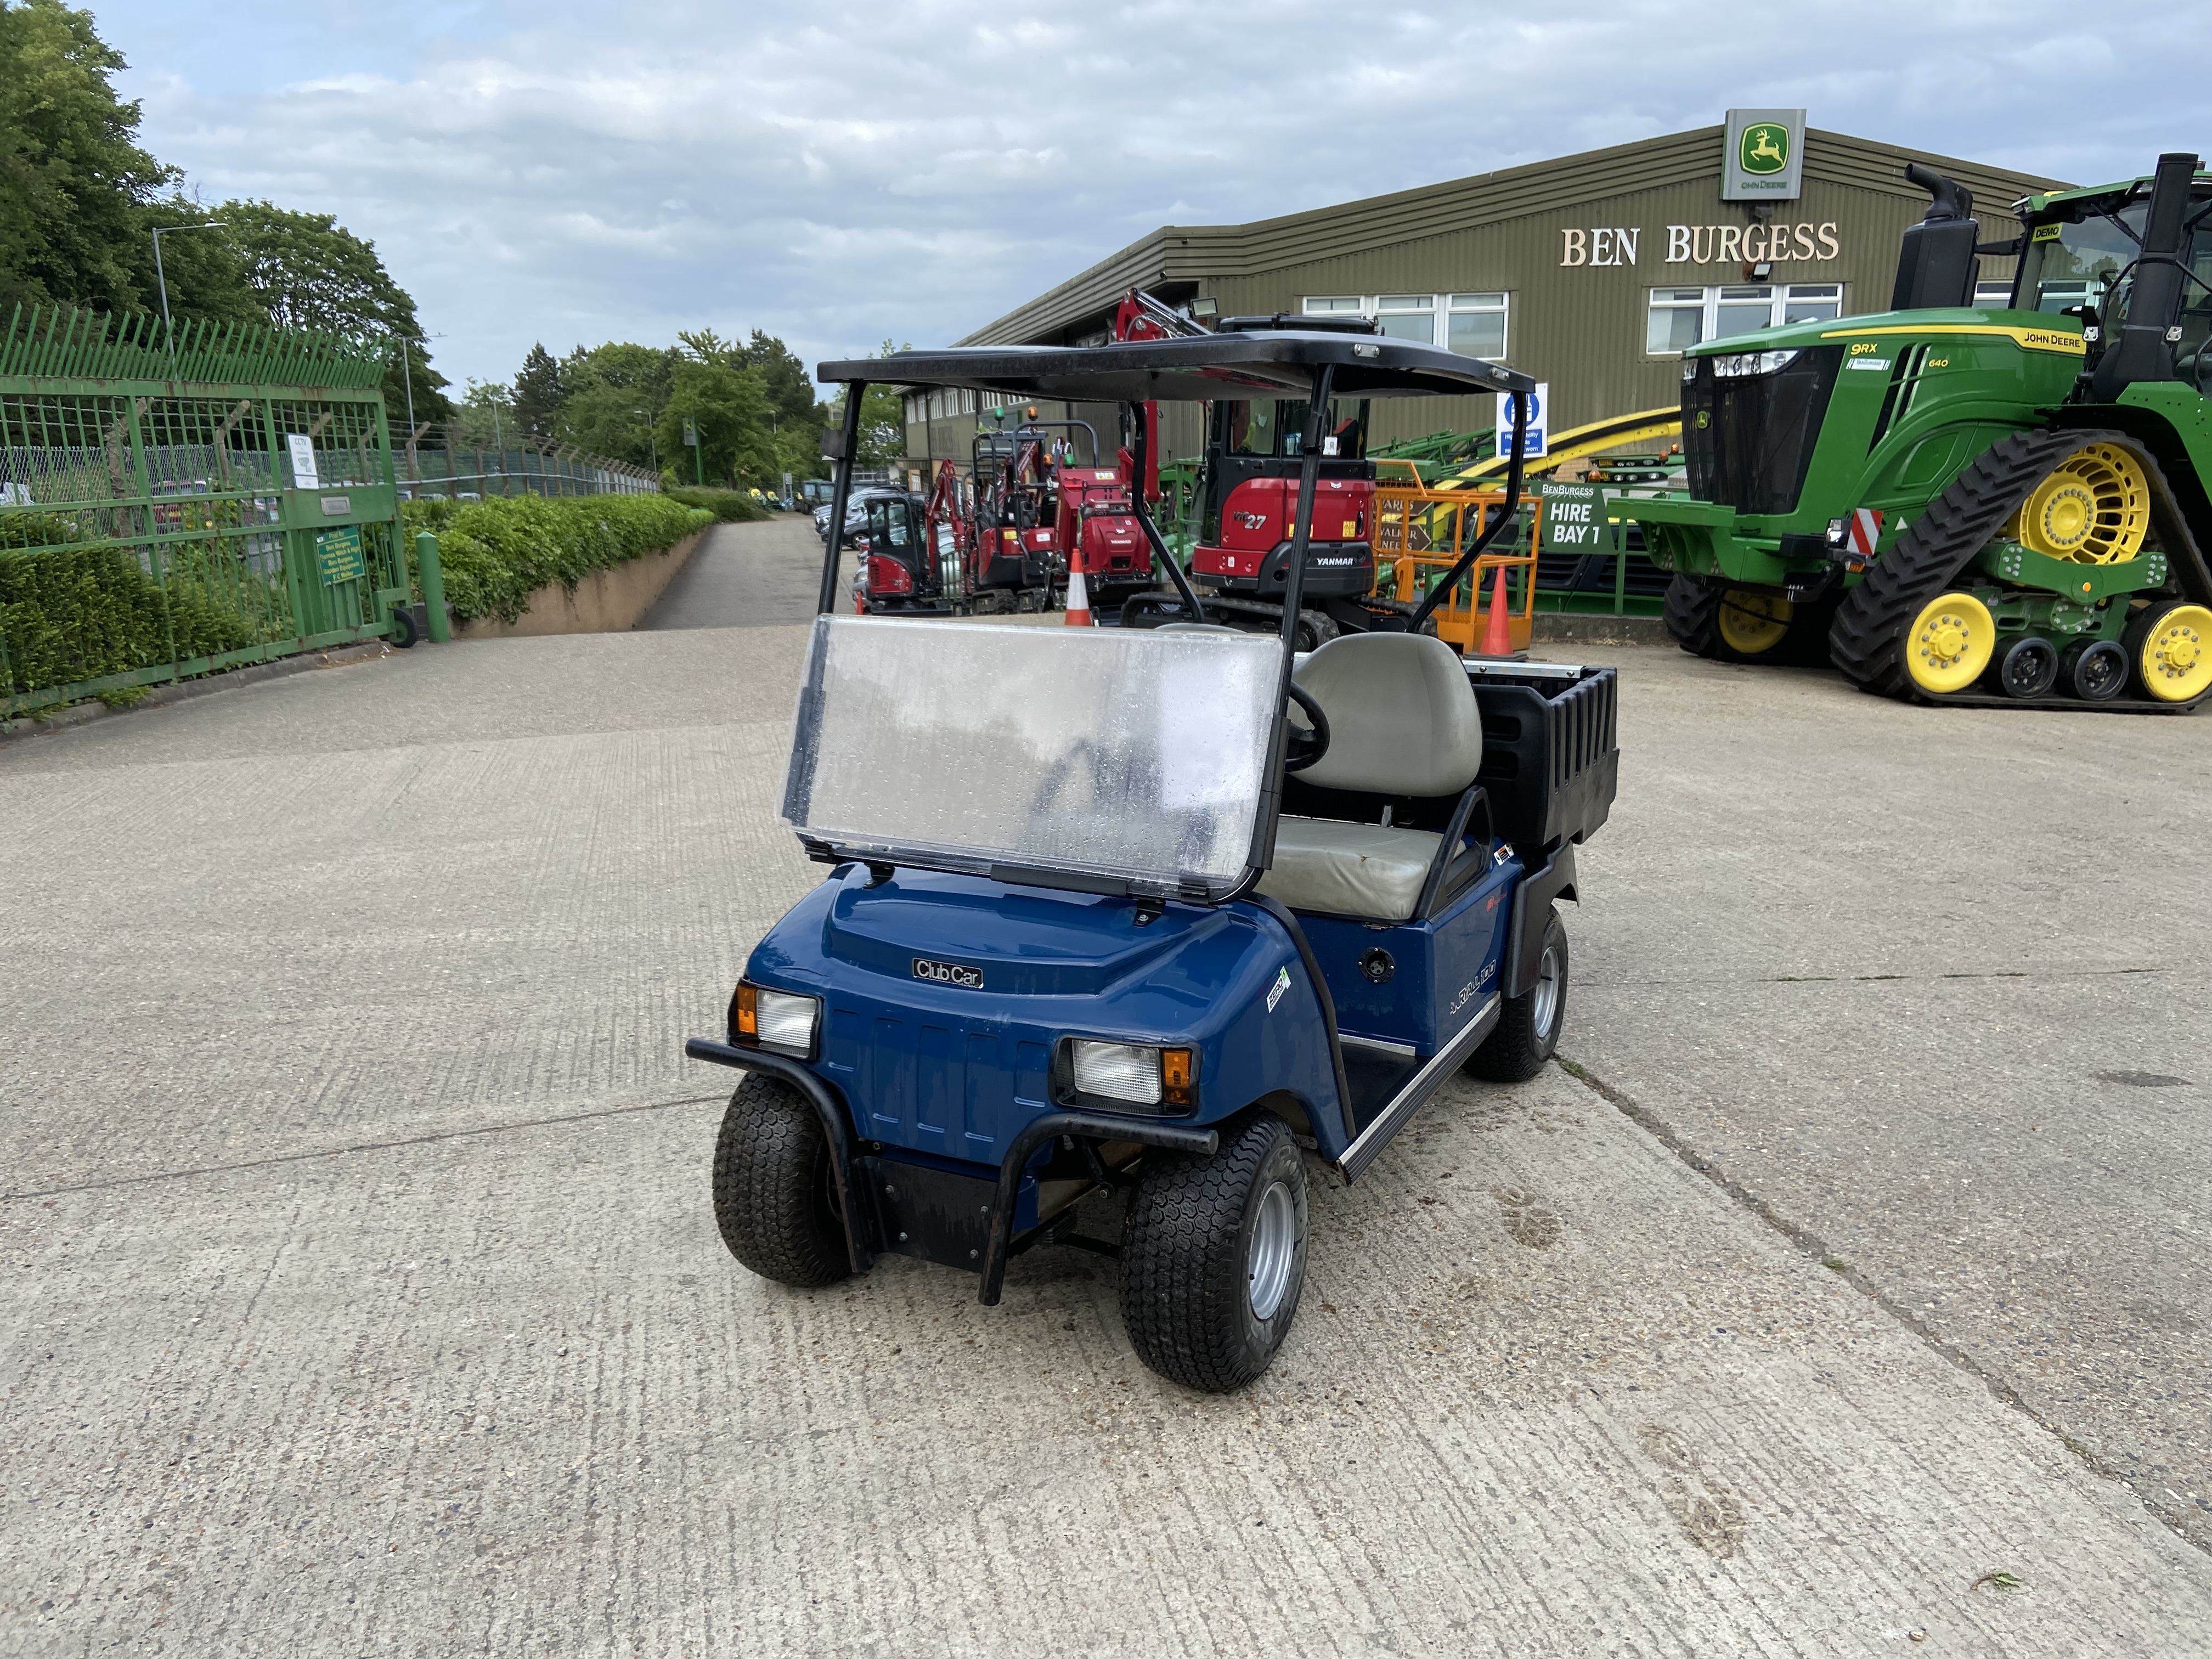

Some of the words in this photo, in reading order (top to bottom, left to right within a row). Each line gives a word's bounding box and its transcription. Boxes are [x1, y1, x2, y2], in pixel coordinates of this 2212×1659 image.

[2036, 227, 2059, 238] DEMO
[1560, 228, 1640, 267] BEN
[1664, 222, 1839, 264] BURGESS
[2024, 331, 2049, 343] JOHN
[2051, 335, 2080, 347] DEERE
[1851, 343, 1878, 356] 9RX
[295, 438, 307, 446] CCTV
[1550, 503, 1592, 522] HIRE
[1553, 524, 1588, 544] BAY
[1593, 526, 1599, 544] 1
[1317, 557, 1353, 566] YANMAR
[917, 960, 950, 981] Club
[951, 966, 978, 985] Car
[1481, 959, 1496, 985] 100
[1269, 978, 1283, 1005] ZERO
